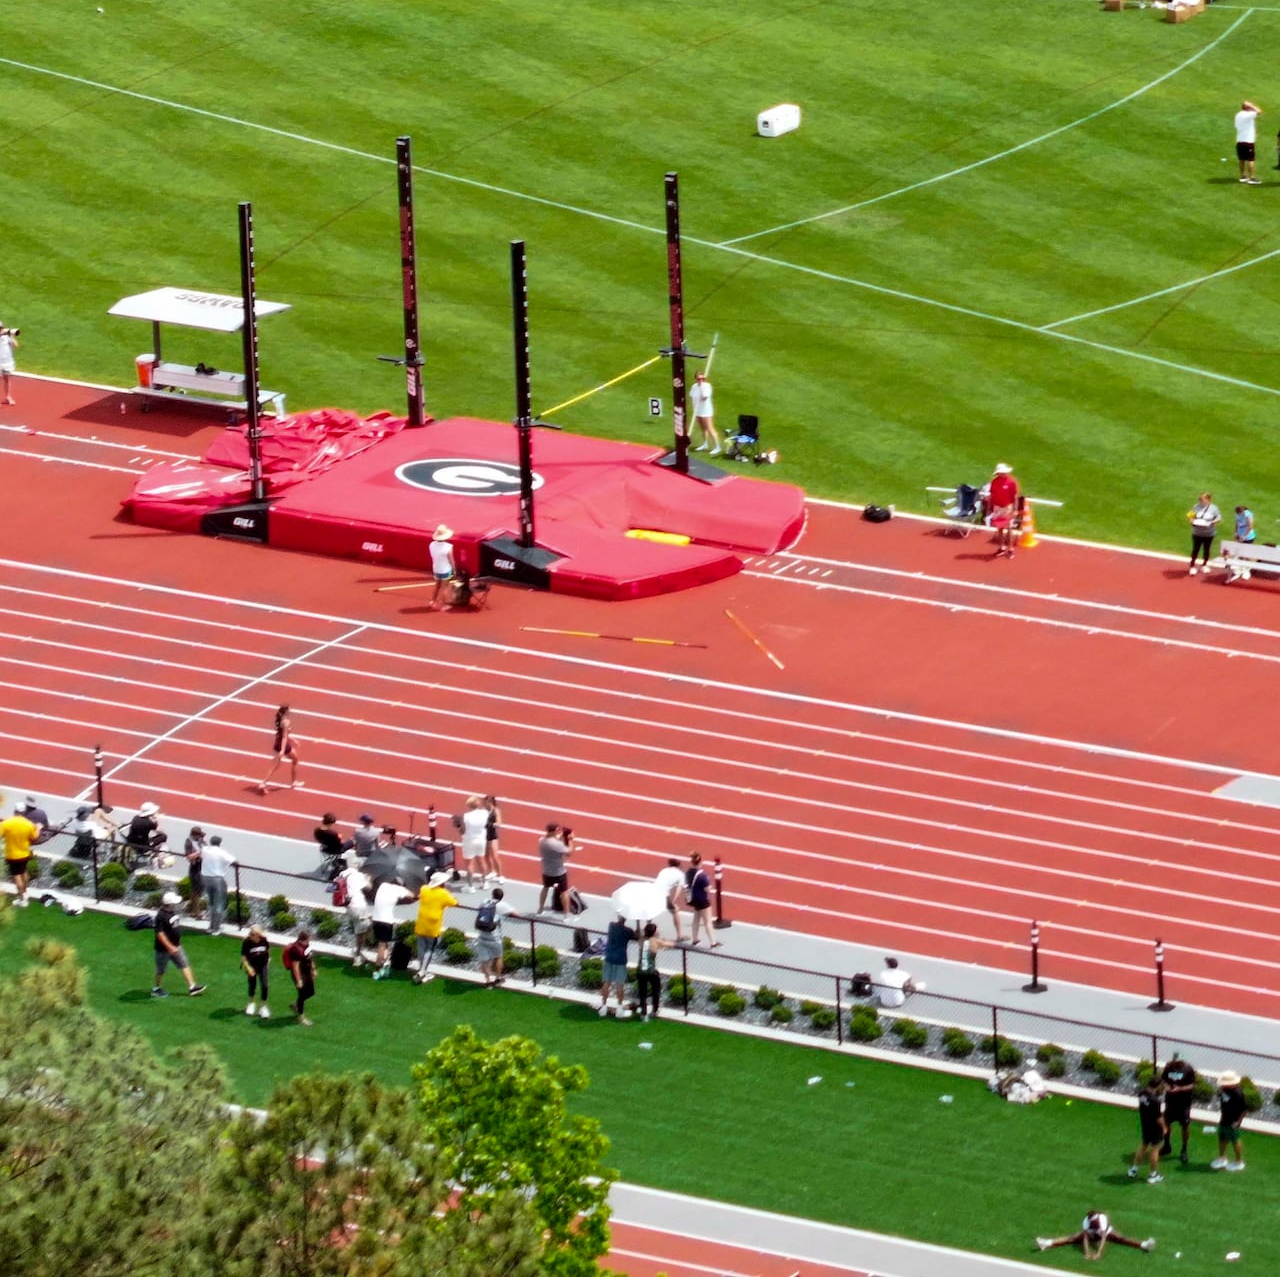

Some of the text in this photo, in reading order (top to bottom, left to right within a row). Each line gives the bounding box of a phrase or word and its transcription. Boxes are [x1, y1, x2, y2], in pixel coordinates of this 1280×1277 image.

[650, 399, 661, 416] B
[233, 516, 255, 529] GILL
[361, 541, 385, 553] GILL
[493, 558, 517, 571] GILL
